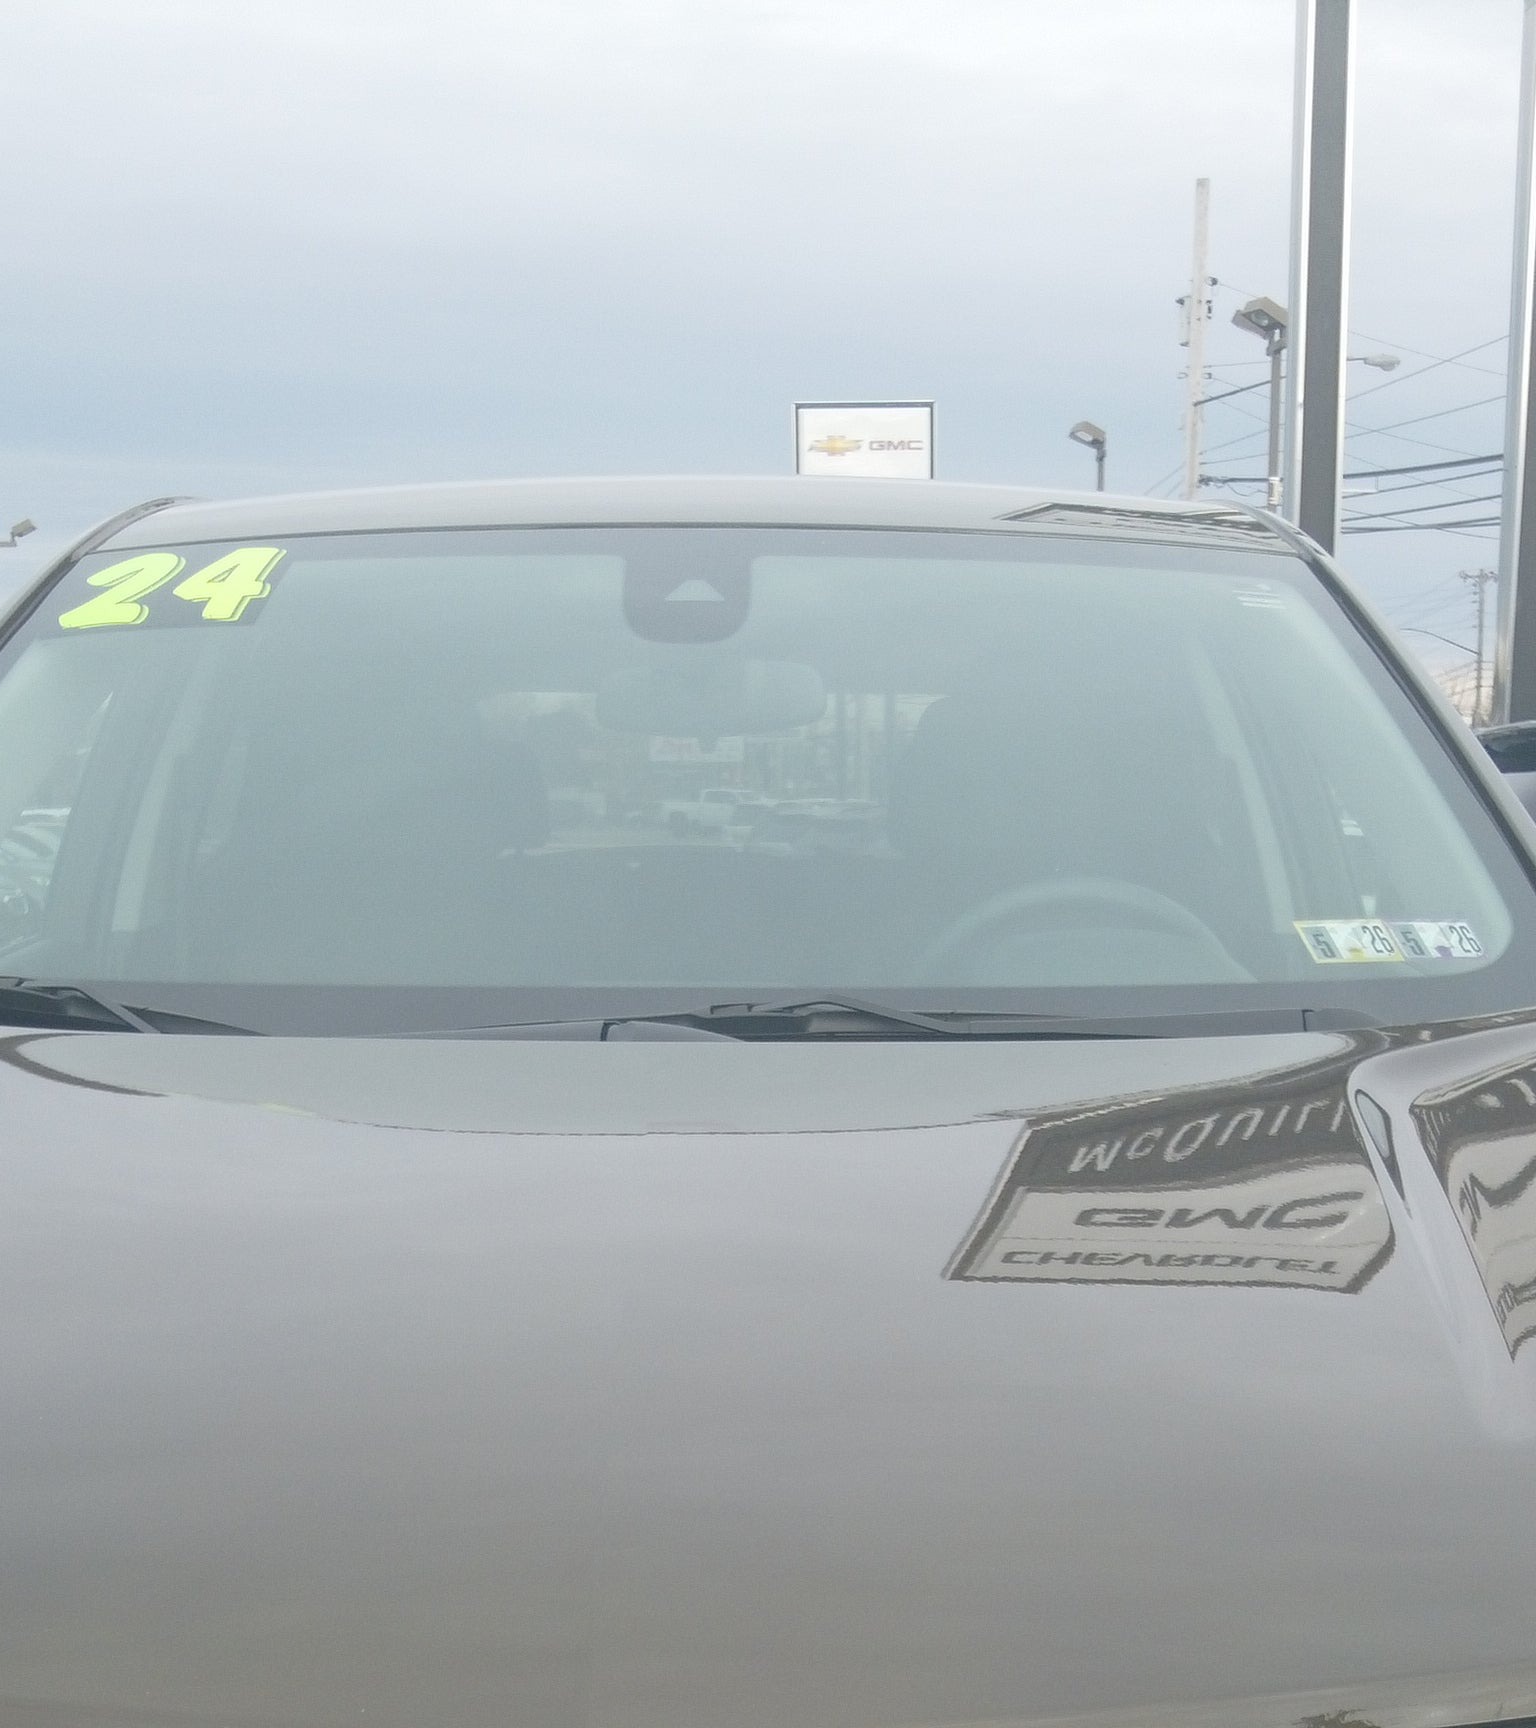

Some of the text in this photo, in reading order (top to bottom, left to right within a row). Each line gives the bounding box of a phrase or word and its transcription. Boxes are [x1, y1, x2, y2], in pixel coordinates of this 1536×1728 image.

[869, 440, 923, 451] GMC
[58, 547, 287, 630] 24
[1313, 925, 1395, 958] 5 26
[1401, 925, 1482, 956] 5 26
